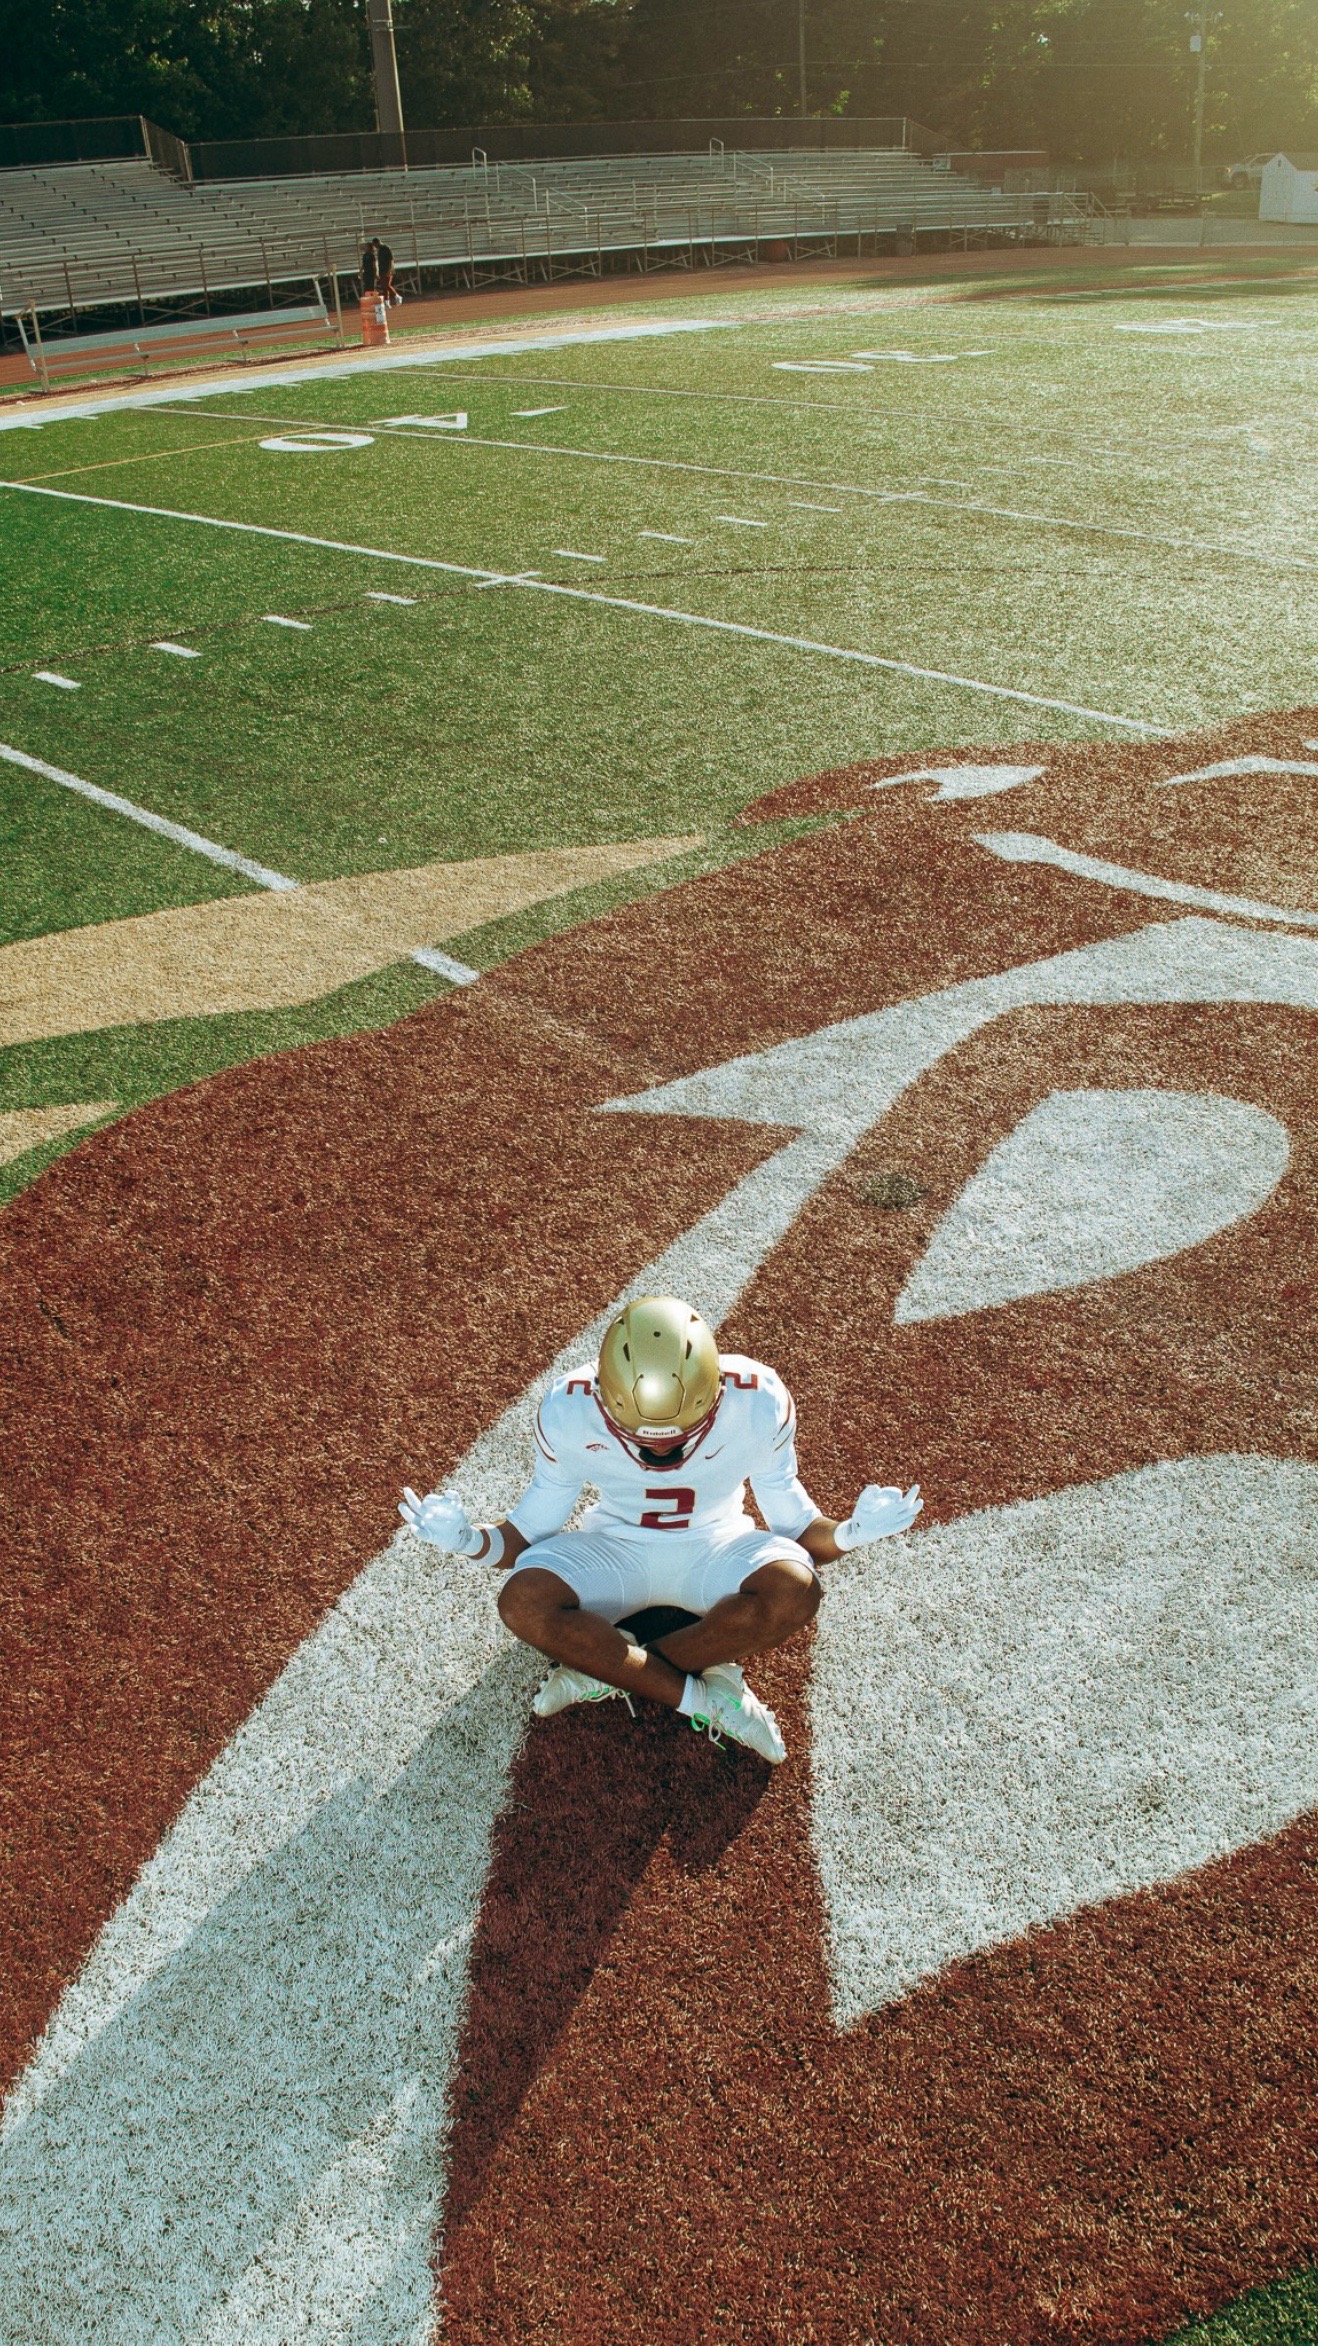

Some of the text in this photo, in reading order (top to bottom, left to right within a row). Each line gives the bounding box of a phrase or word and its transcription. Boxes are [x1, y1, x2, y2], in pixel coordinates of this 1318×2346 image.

[771, 350, 959, 373] 30
[258, 412, 468, 451] 40
[640, 1487, 696, 1531] 2
